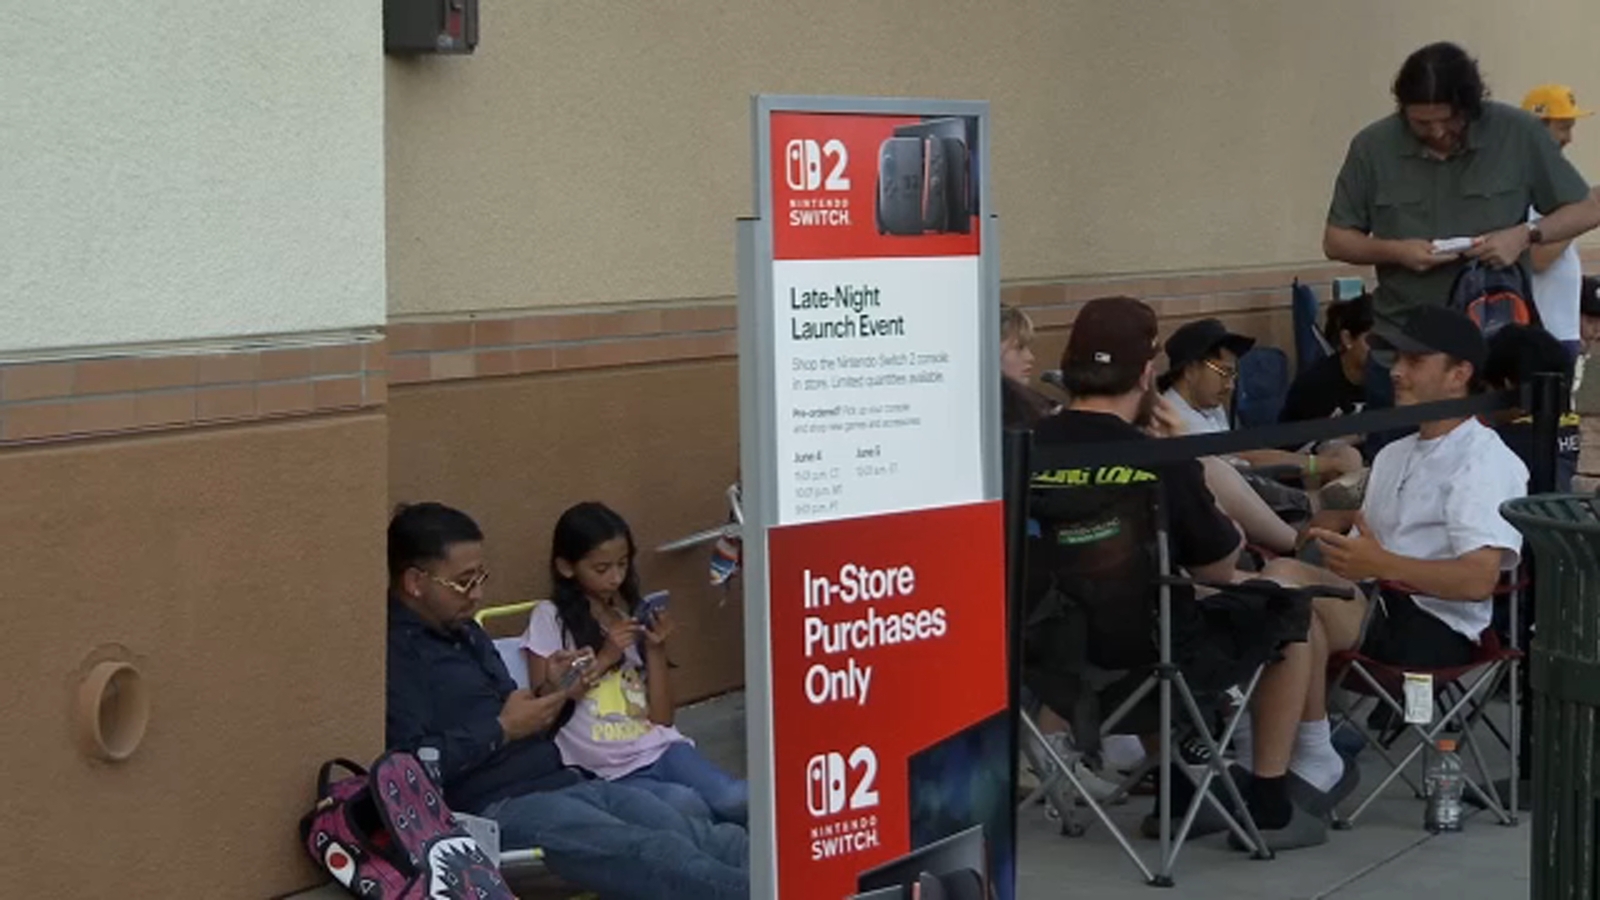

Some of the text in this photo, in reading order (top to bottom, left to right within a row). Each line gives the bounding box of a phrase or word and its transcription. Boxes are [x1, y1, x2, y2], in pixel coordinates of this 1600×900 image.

[789, 199, 849, 208] NINTENDO
[789, 209, 850, 226] SWITCH
[790, 285, 880, 312] Late-Night
[791, 314, 905, 340] Launch Event
[792, 351, 949, 371] Shop the Nintendo Switch 2 console
[792, 377, 802, 390] in
[831, 374, 863, 388] Limited
[866, 373, 906, 388] quantities
[794, 452, 814, 463] June
[856, 448, 874, 459] June
[804, 563, 915, 609] In-Store
[804, 607, 946, 657] Purchases
[804, 657, 872, 706] Only
[811, 815, 877, 838] NINTENDO
[811, 829, 879, 861] SWITCH
